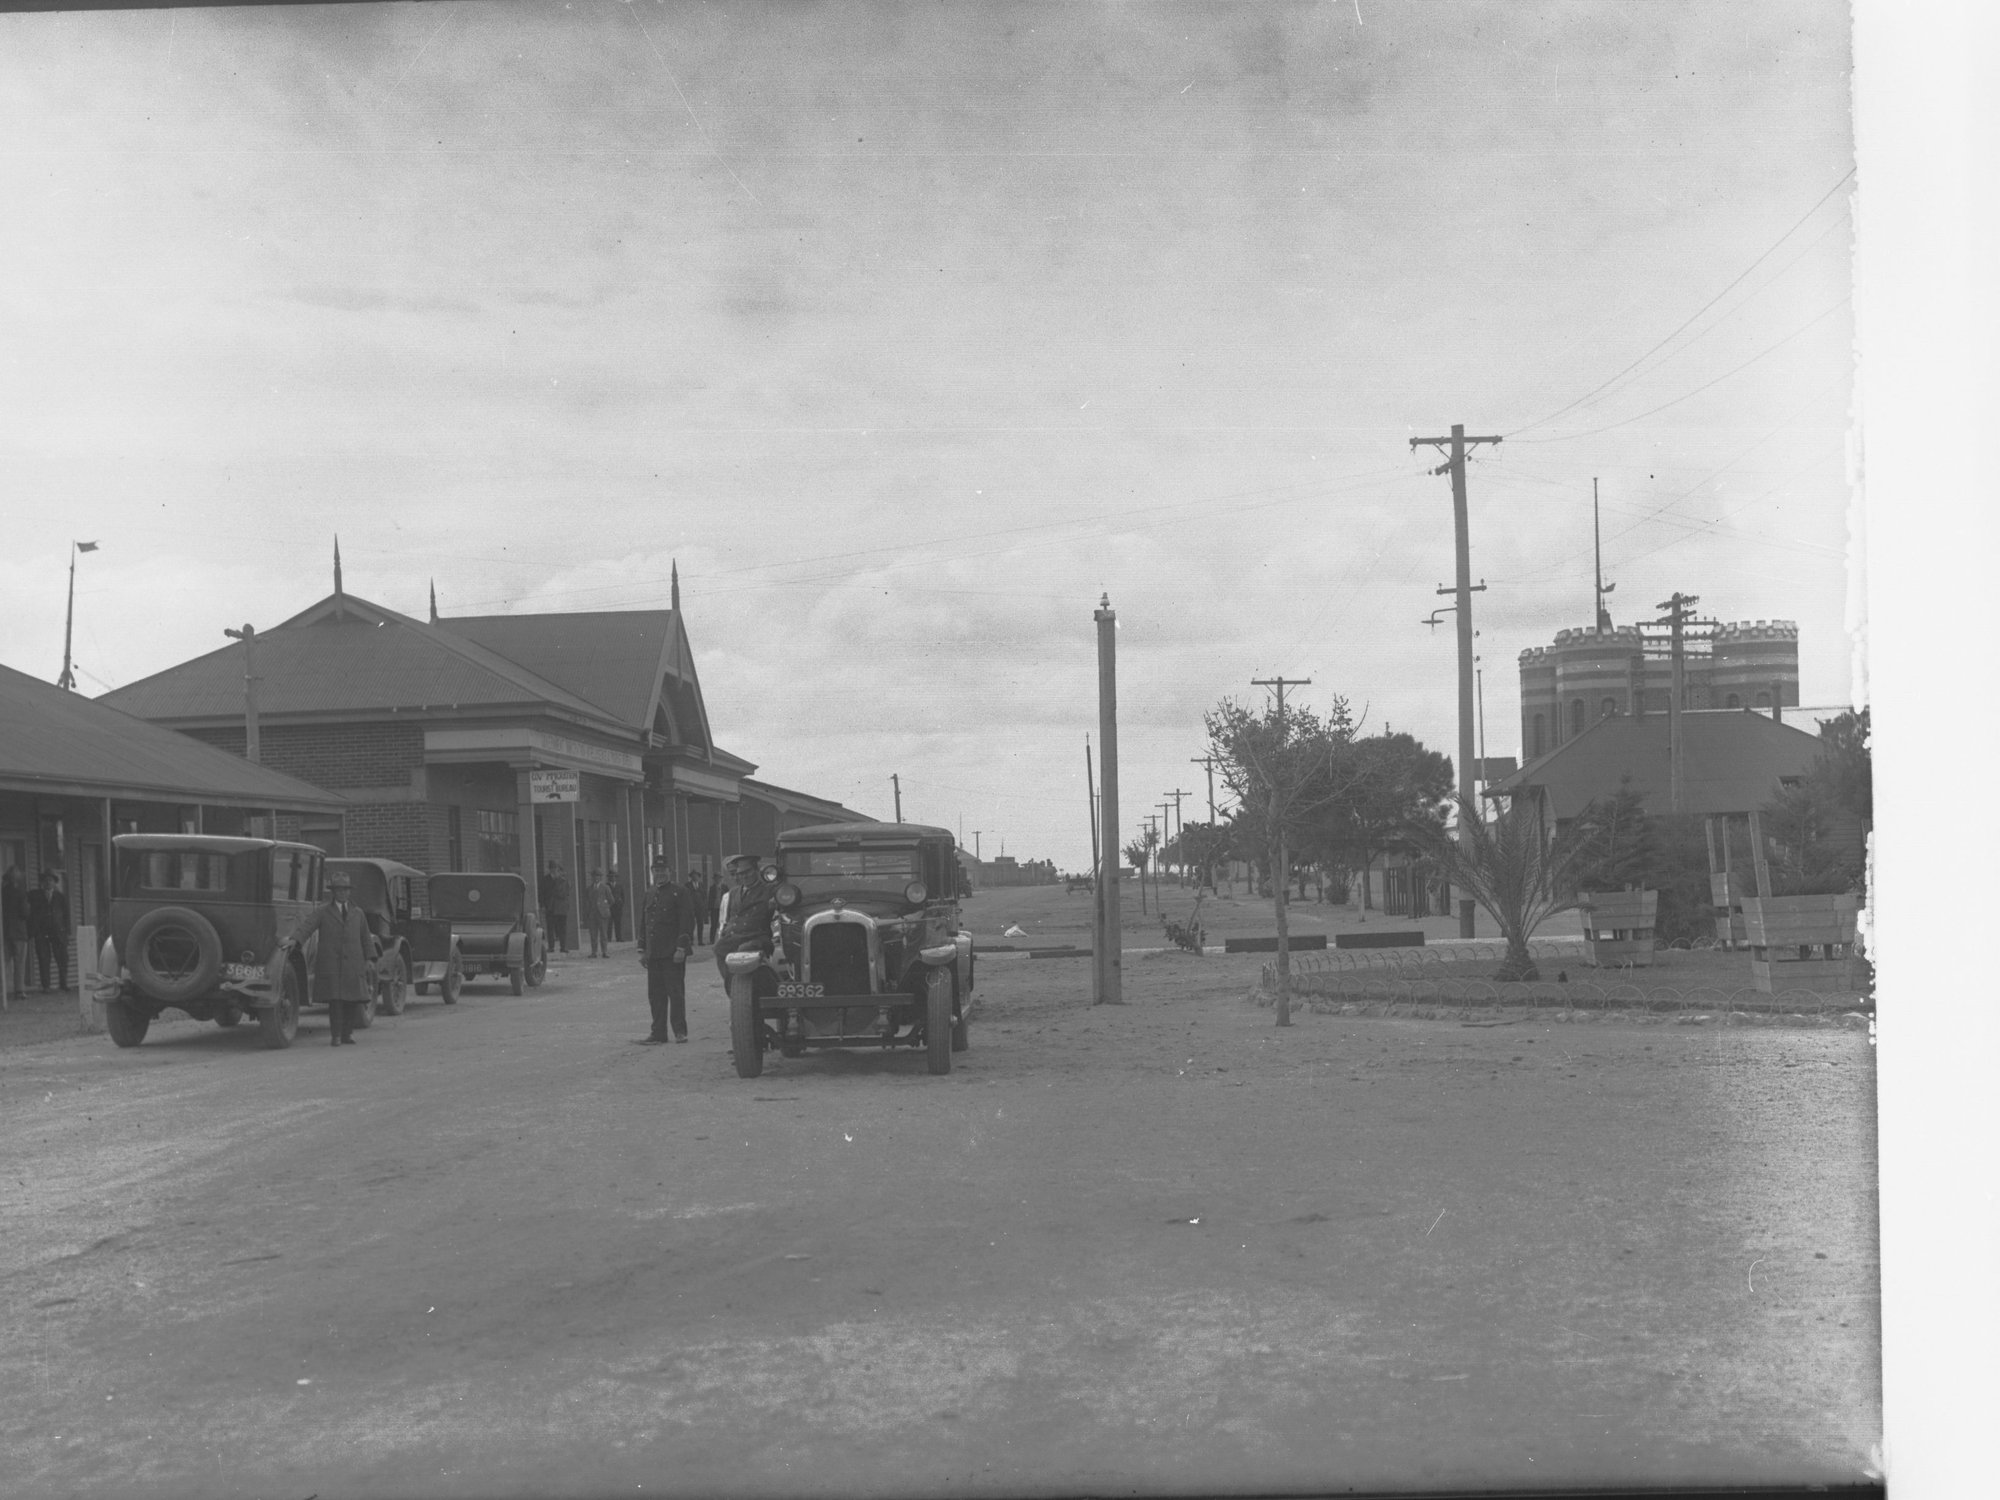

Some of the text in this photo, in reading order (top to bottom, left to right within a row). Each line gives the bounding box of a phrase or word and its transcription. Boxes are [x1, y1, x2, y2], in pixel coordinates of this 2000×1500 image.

[534, 784, 577, 793] TOURIST BUREAU
[777, 984, 825, 998] 69362
